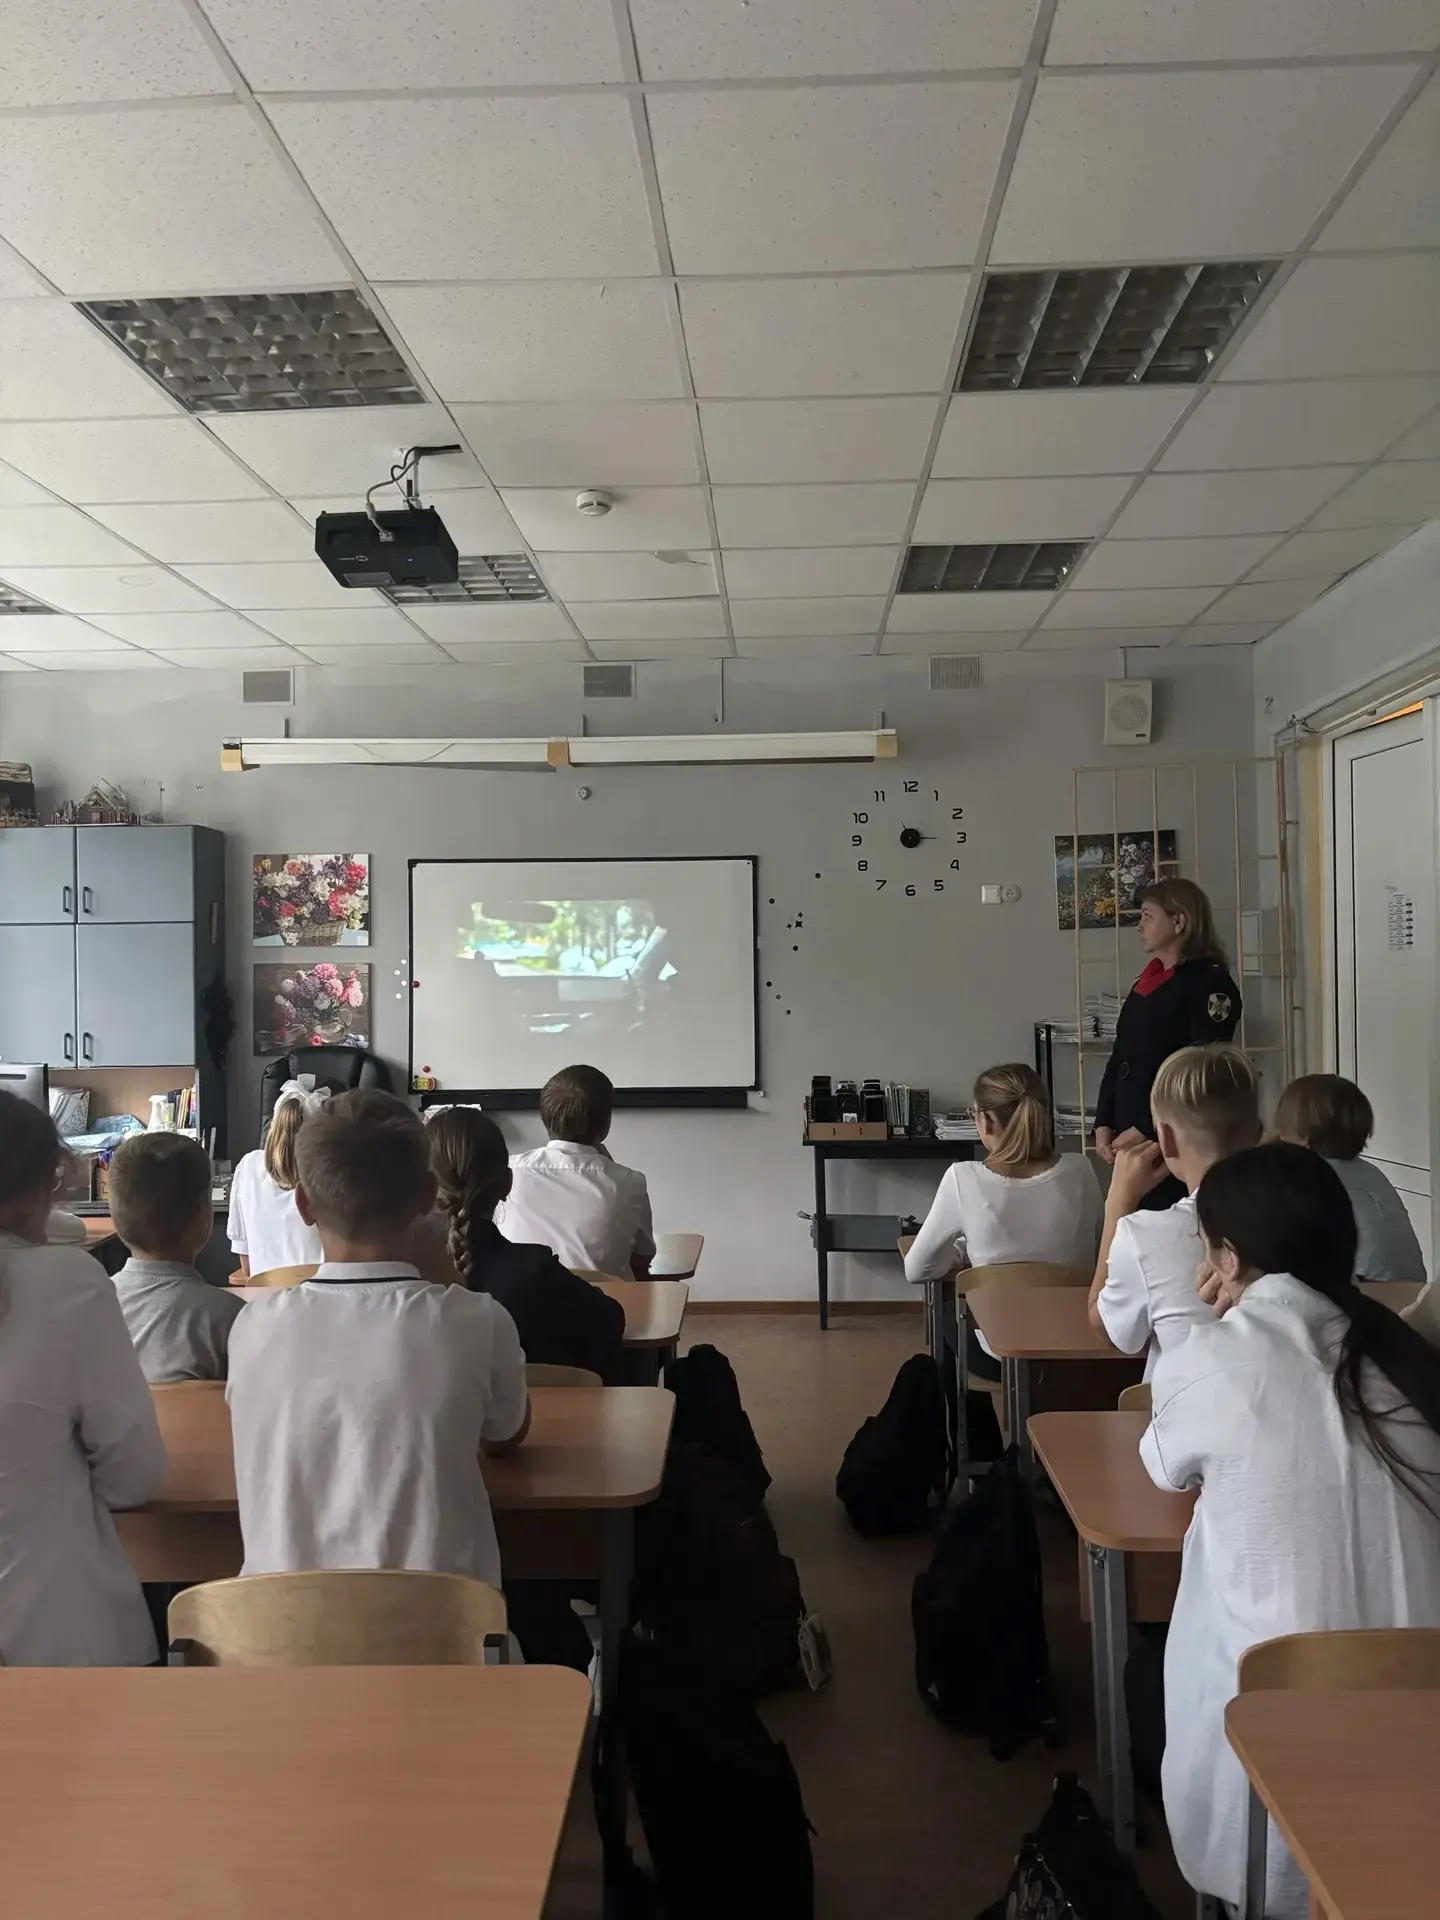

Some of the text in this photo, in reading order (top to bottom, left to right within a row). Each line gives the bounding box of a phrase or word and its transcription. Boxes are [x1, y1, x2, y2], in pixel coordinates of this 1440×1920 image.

[903, 781, 919, 792] 12
[874, 790, 885, 801] 11
[934, 790, 939, 801] 1
[853, 812, 868, 823] 10
[952, 808, 963, 819] 2
[852, 835, 862, 846] 9
[957, 832, 966, 843] 3
[858, 860, 868, 871] 8
[950, 859, 959, 870] 4
[875, 880, 887, 890] 7
[905, 885, 915, 896] 6
[934, 880, 944, 891] 5
